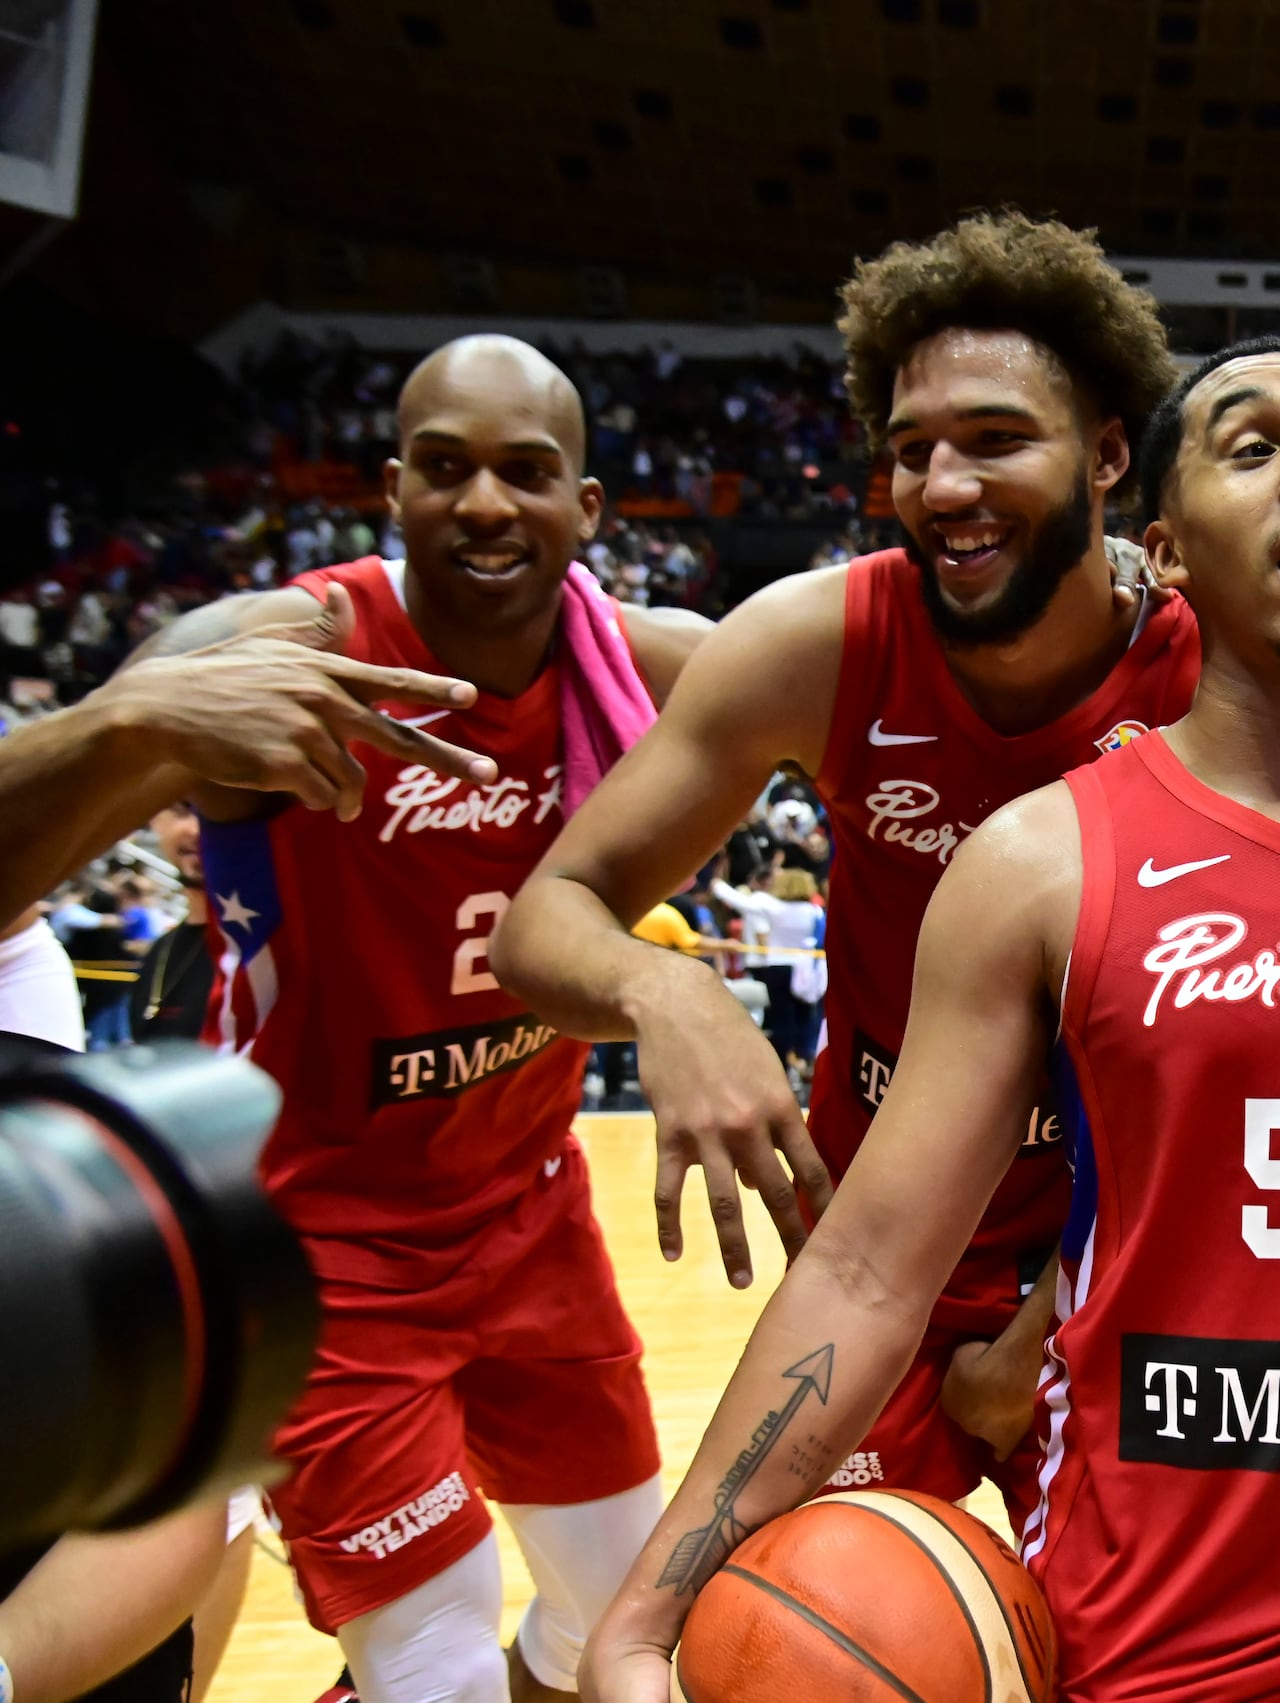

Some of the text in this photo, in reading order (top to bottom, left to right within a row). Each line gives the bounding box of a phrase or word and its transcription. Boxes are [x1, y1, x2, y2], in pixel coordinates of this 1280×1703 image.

[378, 764, 531, 842] Puerto
[866, 779, 977, 865] Puer
[367, 1492, 465, 1559] TEANDO
